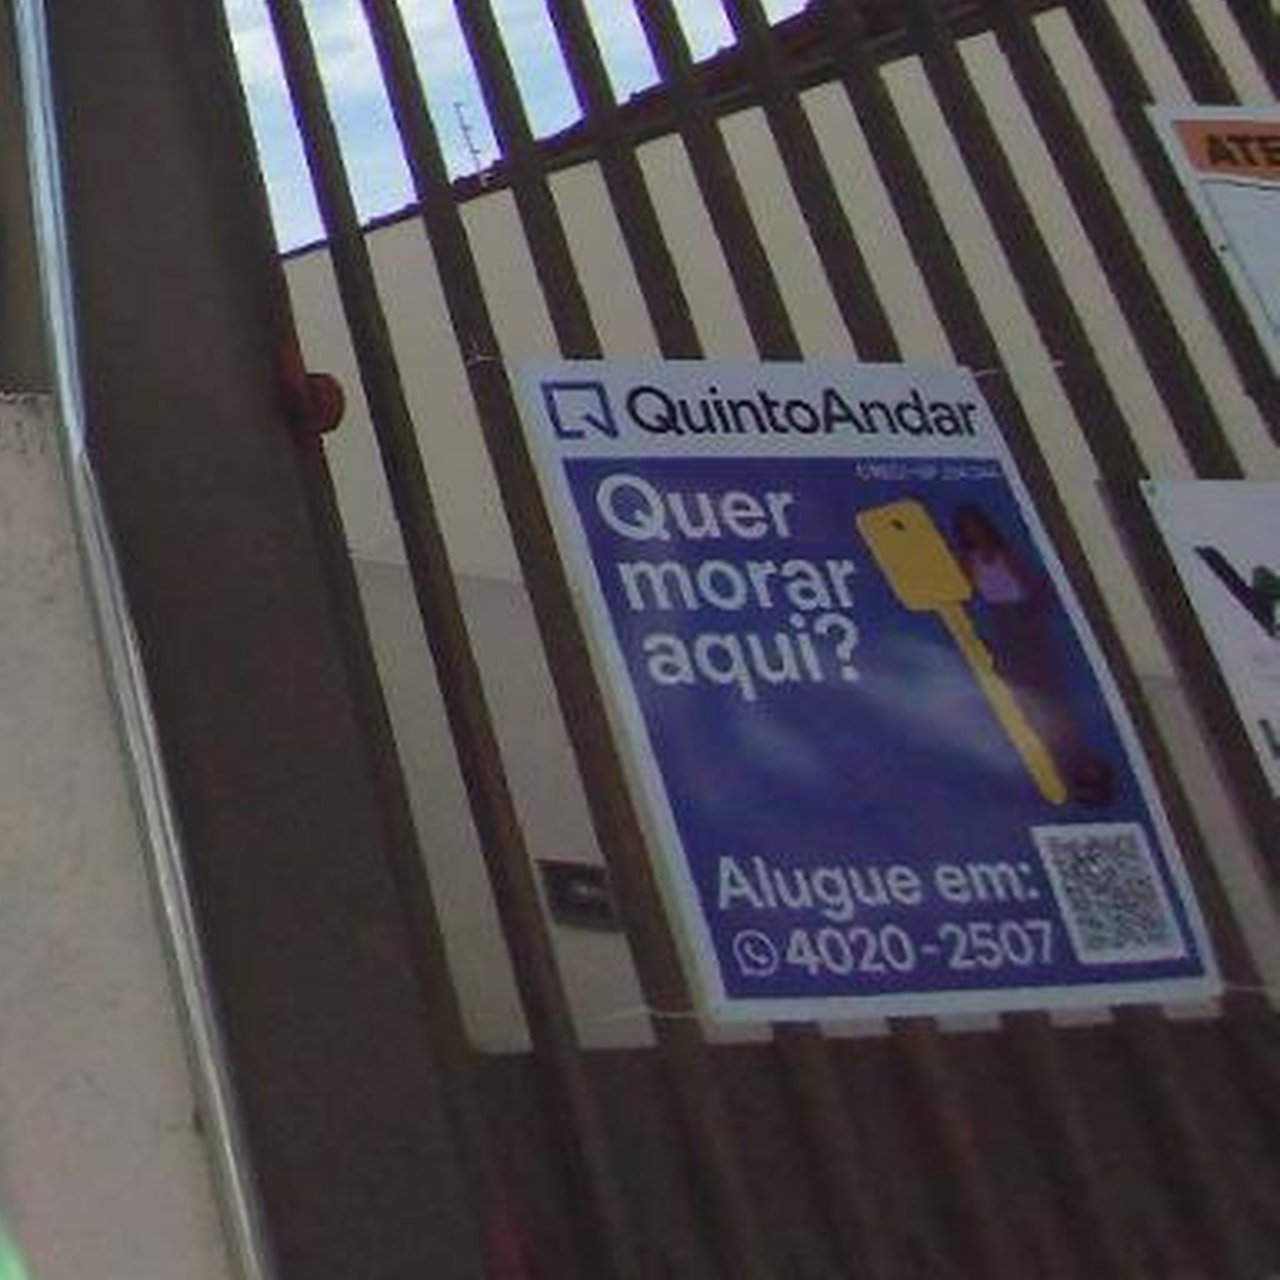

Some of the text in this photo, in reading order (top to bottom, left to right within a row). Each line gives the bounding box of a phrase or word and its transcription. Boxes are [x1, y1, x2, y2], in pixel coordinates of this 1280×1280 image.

[626, 385, 977, 438] QuintoAndar
[596, 473, 794, 541] Quer
[617, 559, 855, 611] morar
[643, 612, 860, 701] aqui?
[718, 855, 1042, 921] Alugue em:
[786, 919, 1053, 975] 4020-2507
